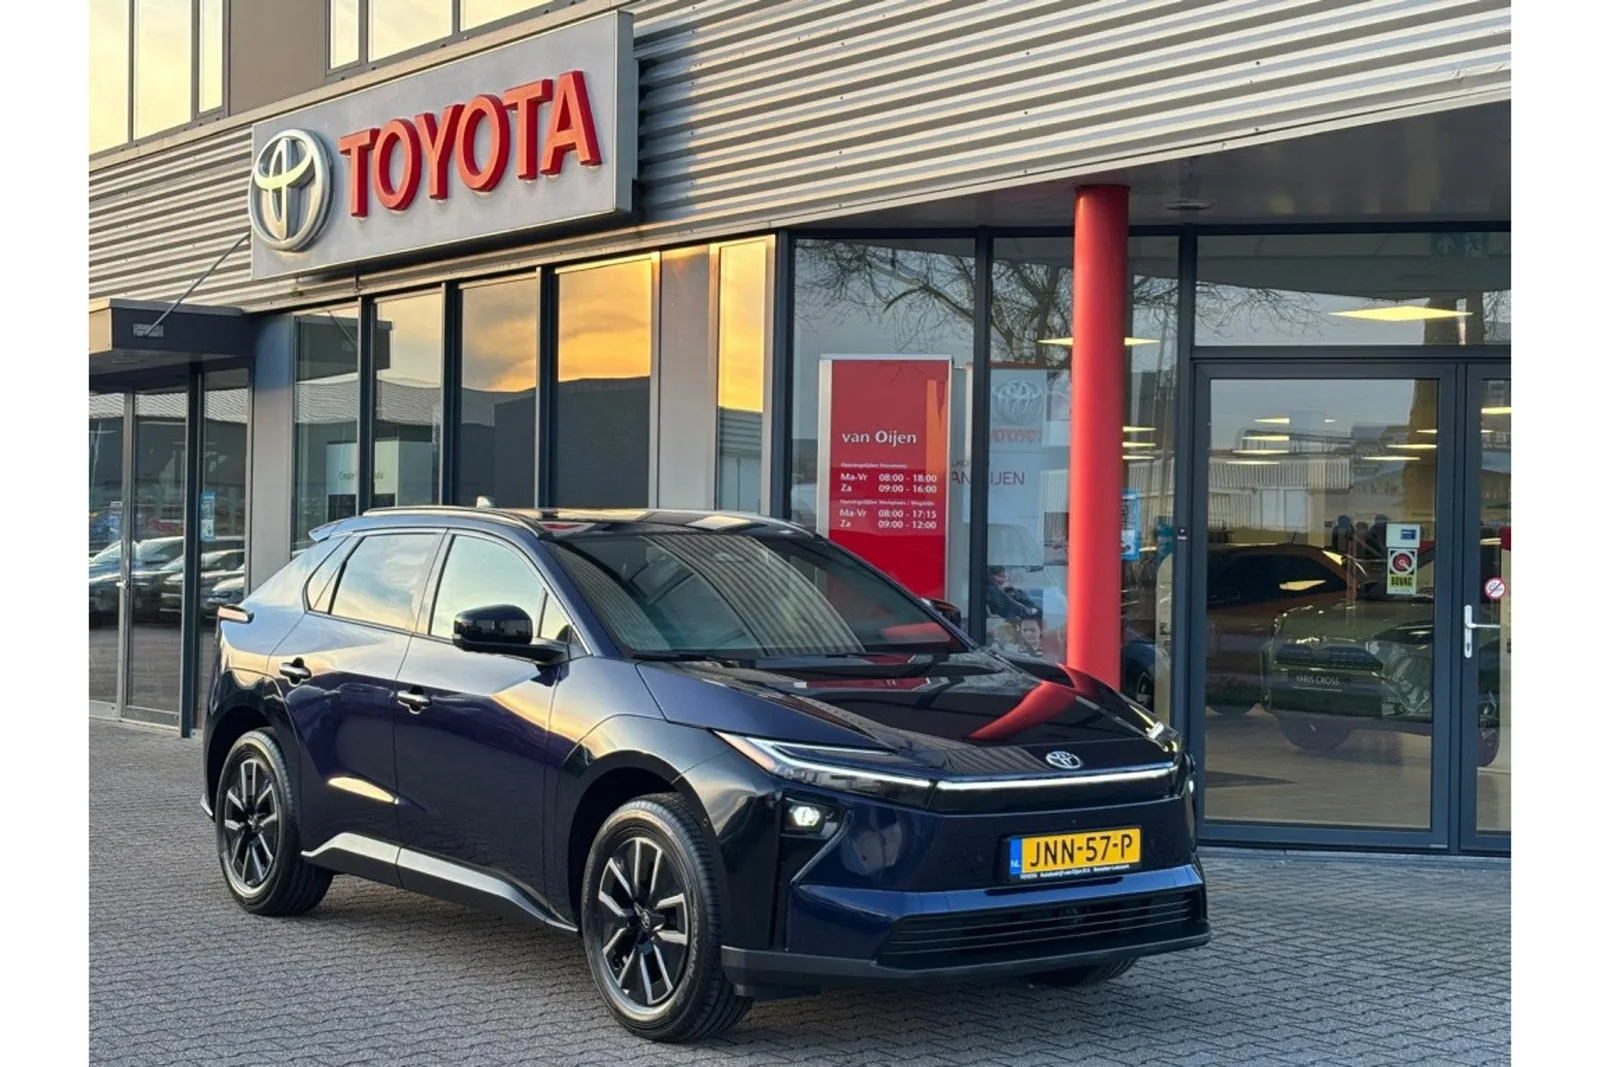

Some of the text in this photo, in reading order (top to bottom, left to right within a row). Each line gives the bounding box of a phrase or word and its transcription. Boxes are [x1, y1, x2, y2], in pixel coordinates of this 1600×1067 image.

[338, 69, 602, 219] TOYOTA
[841, 430, 917, 447] van Oijen
[840, 473, 868, 481] Ma-Vr
[878, 473, 904, 482] 08:00
[913, 474, 937, 483] 18:00
[840, 484, 852, 492] Za
[878, 484, 904, 493] 09:00
[913, 485, 937, 493] 16:00
[839, 509, 867, 517] Ma-Vr
[878, 509, 904, 518] 08:00
[912, 509, 937, 519] 17:15
[839, 520, 851, 528] Za
[878, 520, 904, 529] 09:00
[912, 521, 937, 529] 12:00
[1315, 675, 1340, 686] CROSS
[1030, 834, 1133, 867] JNN-57-P
[1010, 859, 1021, 868] NL
